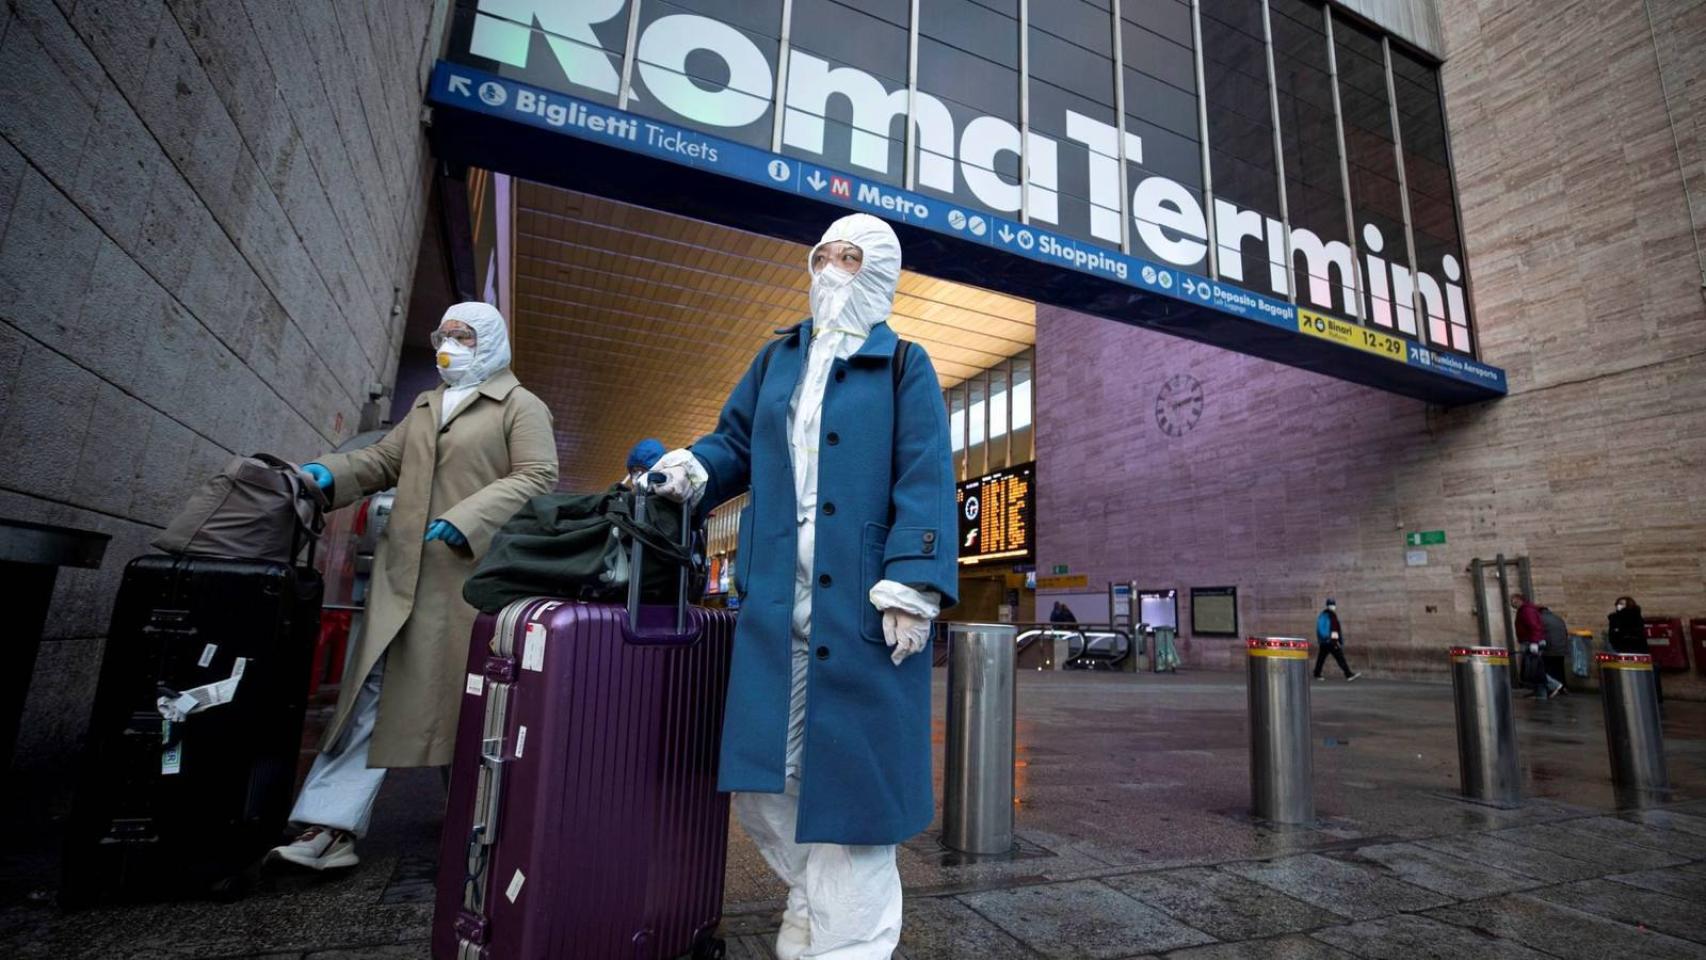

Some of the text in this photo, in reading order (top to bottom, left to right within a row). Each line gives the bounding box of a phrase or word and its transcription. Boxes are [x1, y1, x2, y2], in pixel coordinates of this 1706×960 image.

[515, 89, 718, 162] Biglietti Tickets
[857, 183, 929, 218] Metro
[1039, 235, 1127, 279] Shopping
[1213, 286, 1256, 308] Deposito
[1258, 299, 1294, 319] Bagagli
[1328, 320, 1352, 336] Binari
